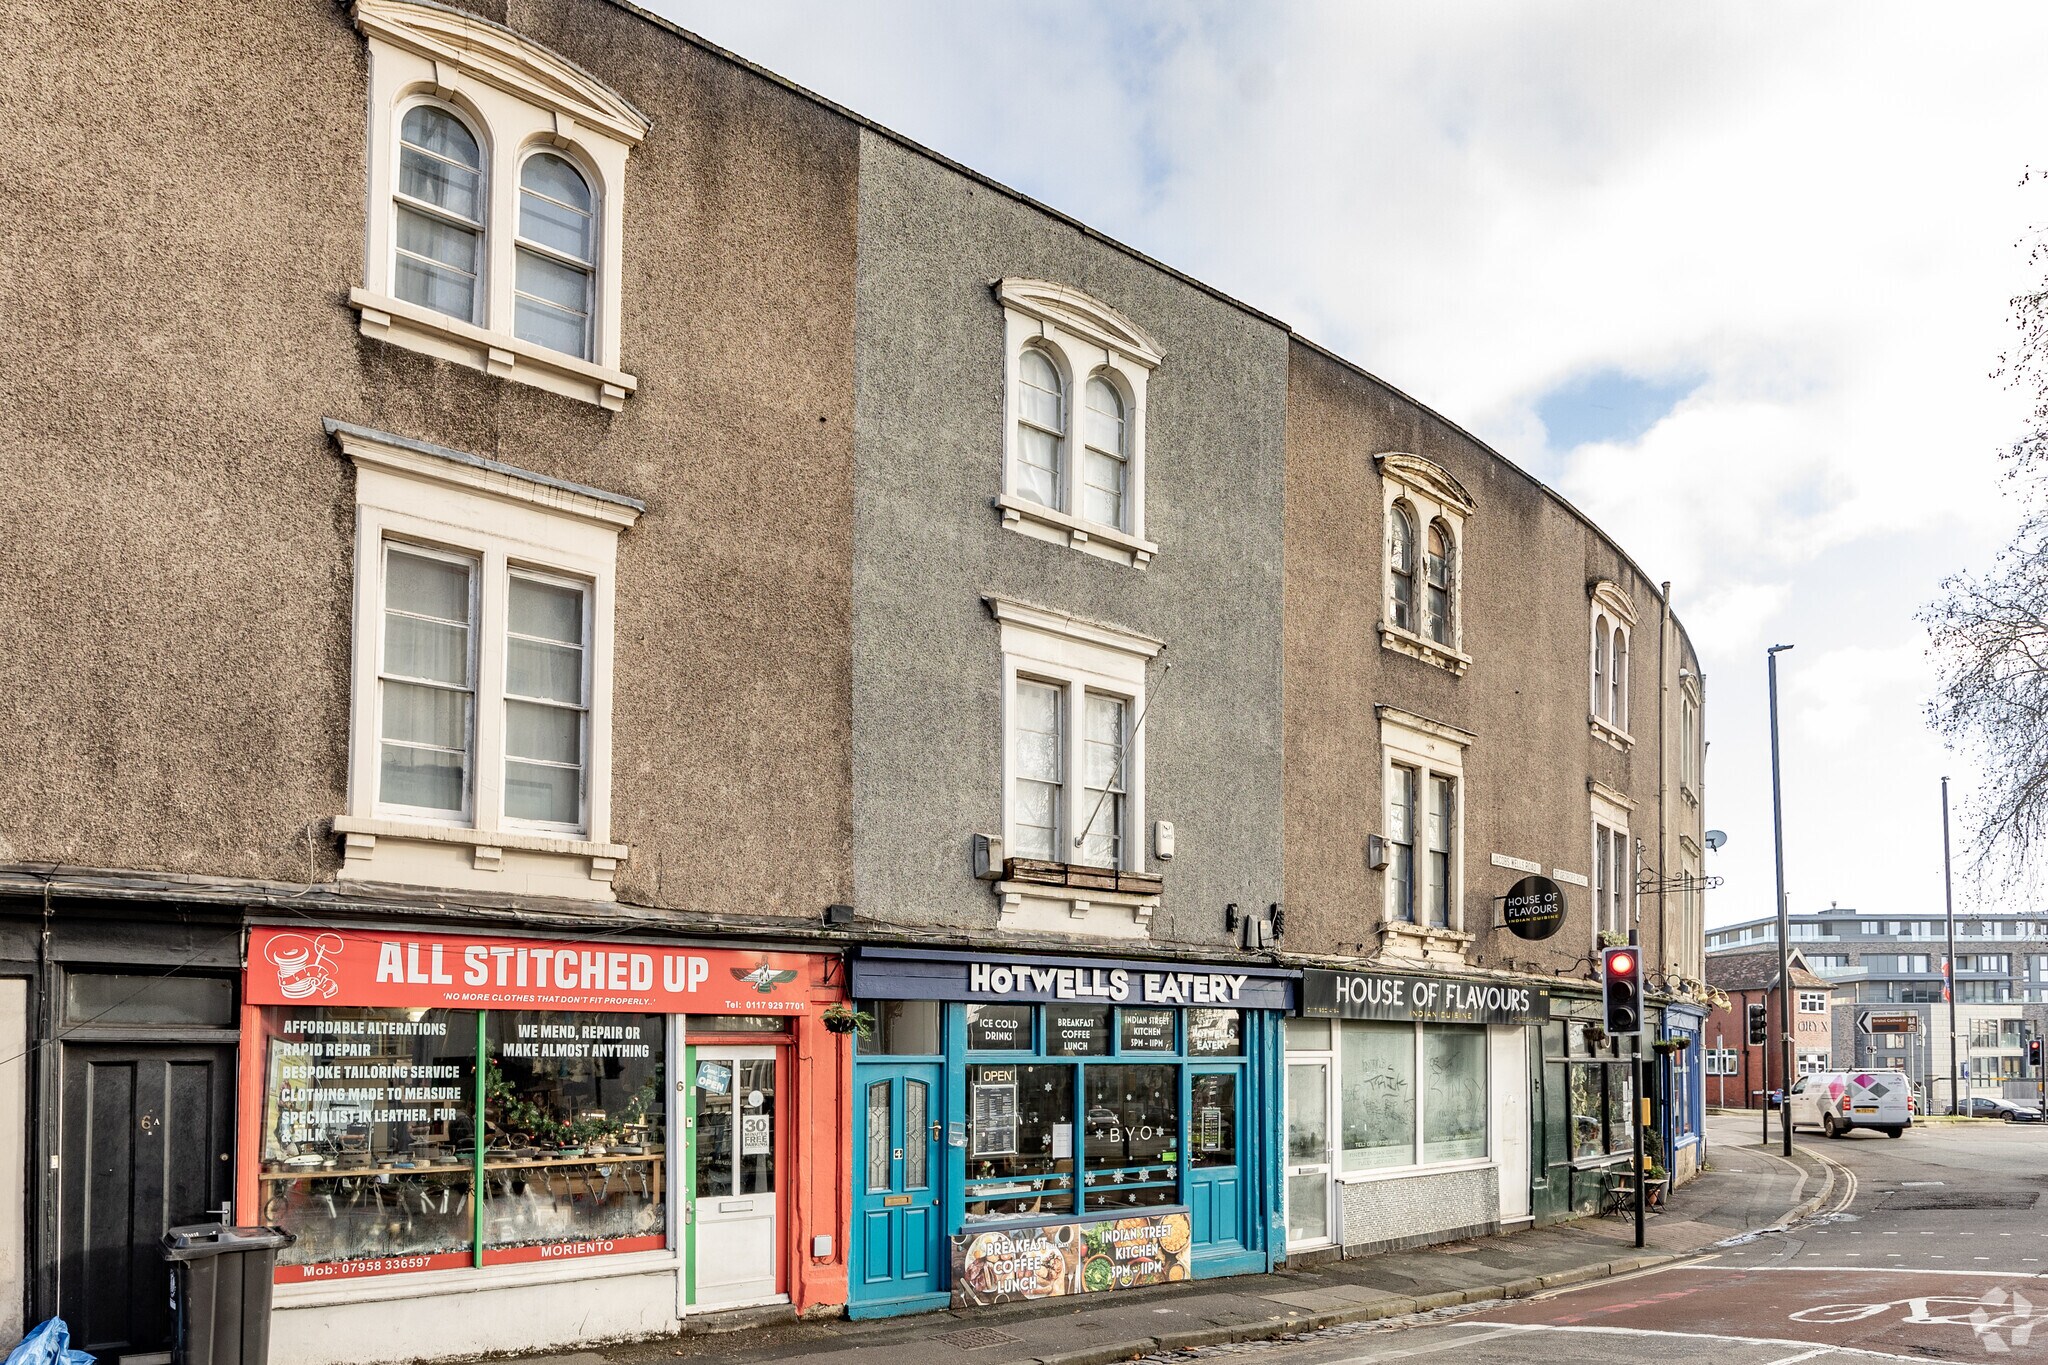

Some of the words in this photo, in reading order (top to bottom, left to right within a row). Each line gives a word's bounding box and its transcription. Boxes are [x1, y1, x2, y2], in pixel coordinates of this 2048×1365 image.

[1508, 894, 1540, 907] HOUSE
[1544, 892, 1558, 902] OF
[1508, 904, 1558, 917] FLAVOURS
[375, 941, 453, 985] ALL
[464, 945, 654, 991] STITCHED
[663, 955, 709, 993] UP
[970, 963, 1130, 1001] HOTWELLS
[1144, 971, 1249, 1004] EATERY
[462, 993, 489, 1001] MORE
[491, 994, 535, 1003] CLOTHES
[537, 995, 561, 1003] THAT
[561, 995, 588, 1003] DON'T
[589, 996, 602, 1004] FIT
[1336, 976, 1405, 1007] HOUSE
[1412, 982, 1440, 1008] OF
[1445, 984, 1531, 1013] FLAVOURS
[725, 1000, 742, 1009] Tel:
[746, 1001, 767, 1009] 0117
[768, 1001, 784, 1010] 929
[784, 1002, 805, 1010] 7701
[1125, 1016, 1148, 1025] INDIAN
[1148, 1016, 1169, 1026] STREET
[1409, 1010, 1437, 1019] INDIAN
[1440, 1011, 1473, 1020] CUISINE
[283, 1020, 365, 1035] AFFORDABLE
[367, 1022, 447, 1036] ALTERATIONS
[979, 1018, 993, 1028] ICE
[995, 1019, 1018, 1029] COLD
[1057, 1018, 1095, 1028] BREAKFAST
[518, 1024, 538, 1039] WE
[541, 1024, 579, 1041] MEND,
[582, 1025, 622, 1040] REPAIR
[625, 1026, 641, 1040] OR
[985, 1031, 1013, 1041] DRINKS
[1061, 1030, 1090, 1039] COFFEE
[1133, 1027, 1161, 1036] KITCHEN
[1192, 1028, 1235, 1040] HOTWELLS
[1063, 1041, 1088, 1051] LUNCH
[1130, 1038, 1144, 1047] 5PM
[1149, 1038, 1164, 1047] 11PM
[1196, 1039, 1230, 1051] EATERY
[283, 1043, 323, 1057] RAPID
[326, 1043, 371, 1057] REPAIR
[503, 1043, 539, 1057] MAKE
[541, 1043, 590, 1058] ALMOST
[591, 1044, 650, 1058] ANYTHING
[282, 1065, 341, 1079] BESPOKE
[344, 1065, 408, 1079] TAILORING
[410, 1065, 460, 1079] SERVICE
[983, 1070, 1012, 1081] OPEN
[676, 1081, 684, 1091] 6
[698, 1076, 724, 1091] OPEN
[281, 1087, 345, 1102] CLOTHING
[348, 1087, 384, 1101] MADE
[387, 1087, 401, 1101] TO
[404, 1087, 461, 1100] MEASURE
[281, 1109, 355, 1125] SPECIALIST
[358, 1109, 372, 1123] IN
[374, 1108, 431, 1124] LEATHER,
[434, 1108, 457, 1121] FUR
[744, 1118, 767, 1132] 30
[281, 1130, 292, 1143] &
[294, 1129, 326, 1142] SILK
[1110, 1125, 1153, 1143] B.Y.O
[895, 1149, 902, 1159] 4
[1101, 1228, 1139, 1244] INDIAN
[1139, 1224, 1173, 1240] STREET
[541, 1241, 614, 1258] MORIENTO
[986, 1237, 1048, 1257] BREAKFAST
[1115, 1244, 1159, 1260] KITCHEN
[303, 1265, 338, 1278] Mob:
[342, 1261, 382, 1274] 07958
[385, 1257, 432, 1271] 336597
[993, 1256, 1041, 1275] COFFEE
[1111, 1263, 1132, 1279] 5PM
[1140, 1260, 1162, 1276] 11PM
[997, 1276, 1038, 1295] LUNCH
